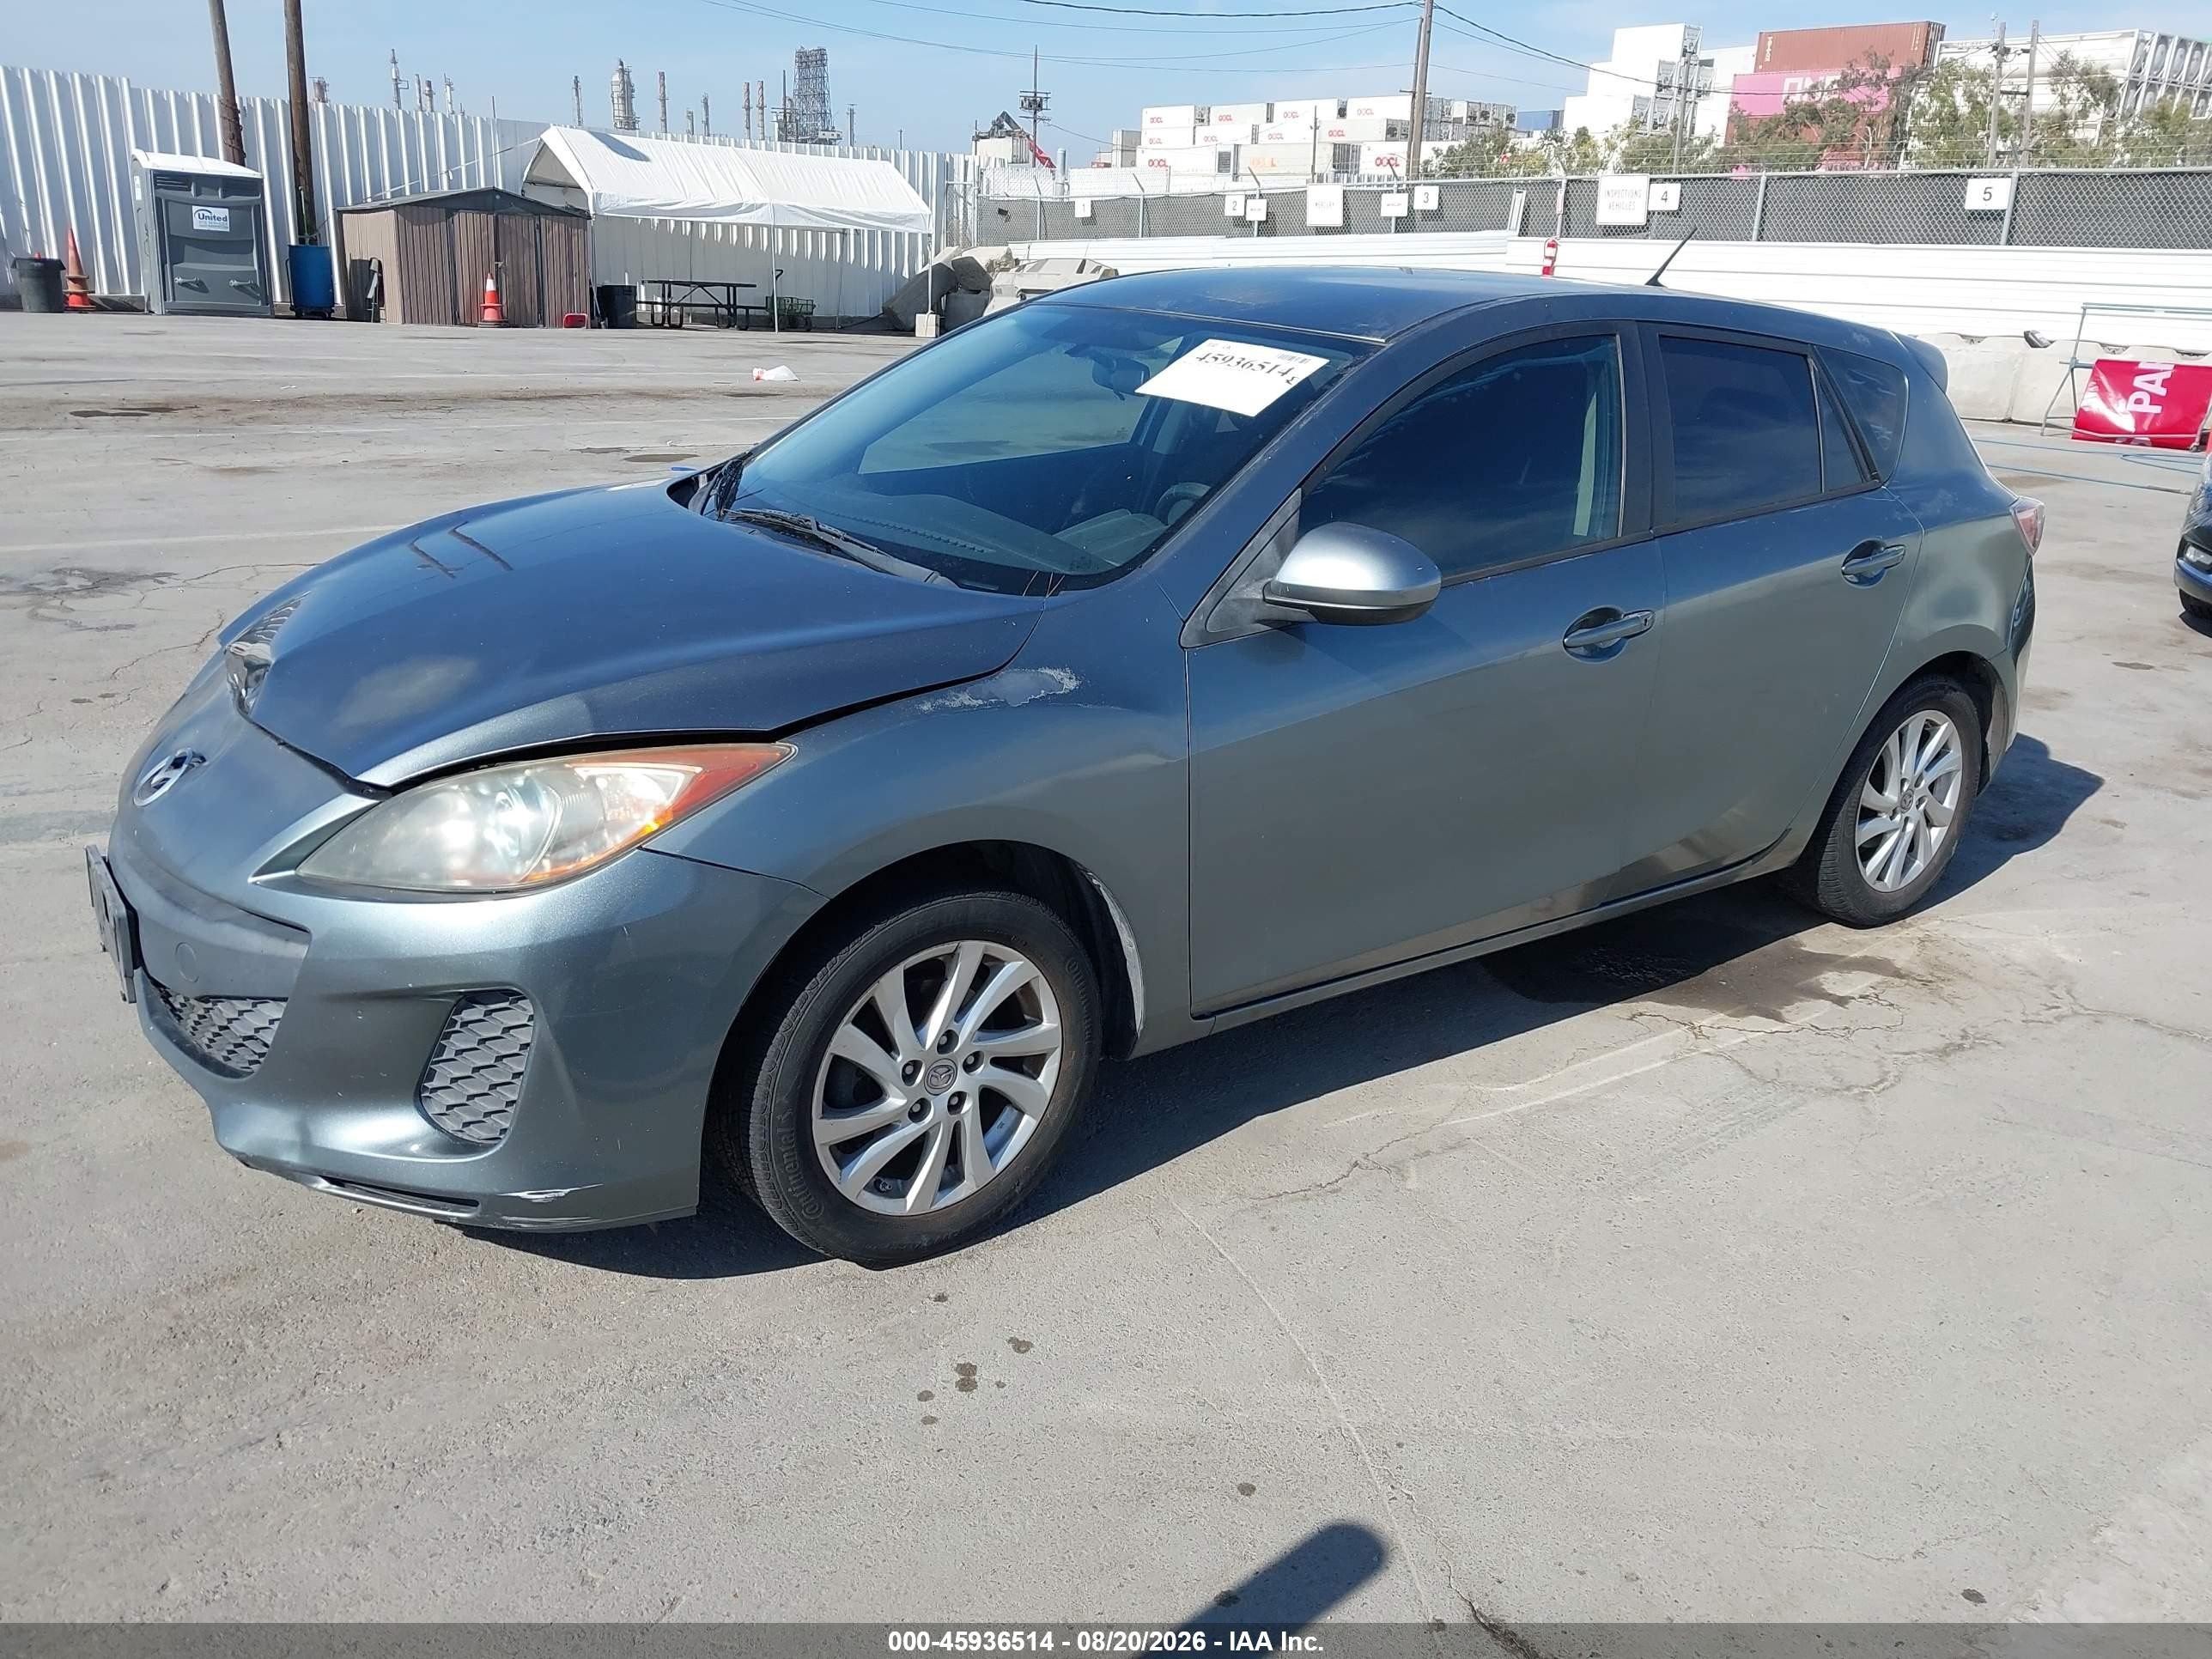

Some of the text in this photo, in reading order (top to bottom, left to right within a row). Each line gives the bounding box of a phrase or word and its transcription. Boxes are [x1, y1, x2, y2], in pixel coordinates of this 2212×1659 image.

[1147, 158, 1169, 168] OOCL
[1375, 155, 1400, 167] OOCL
[1423, 191, 1430, 204] 3
[1661, 191, 1668, 204] 4
[1983, 186, 1993, 202] 5
[1232, 200, 1237, 211] 2
[198, 212, 228, 222] United
[1196, 352, 1295, 377] 45936514
